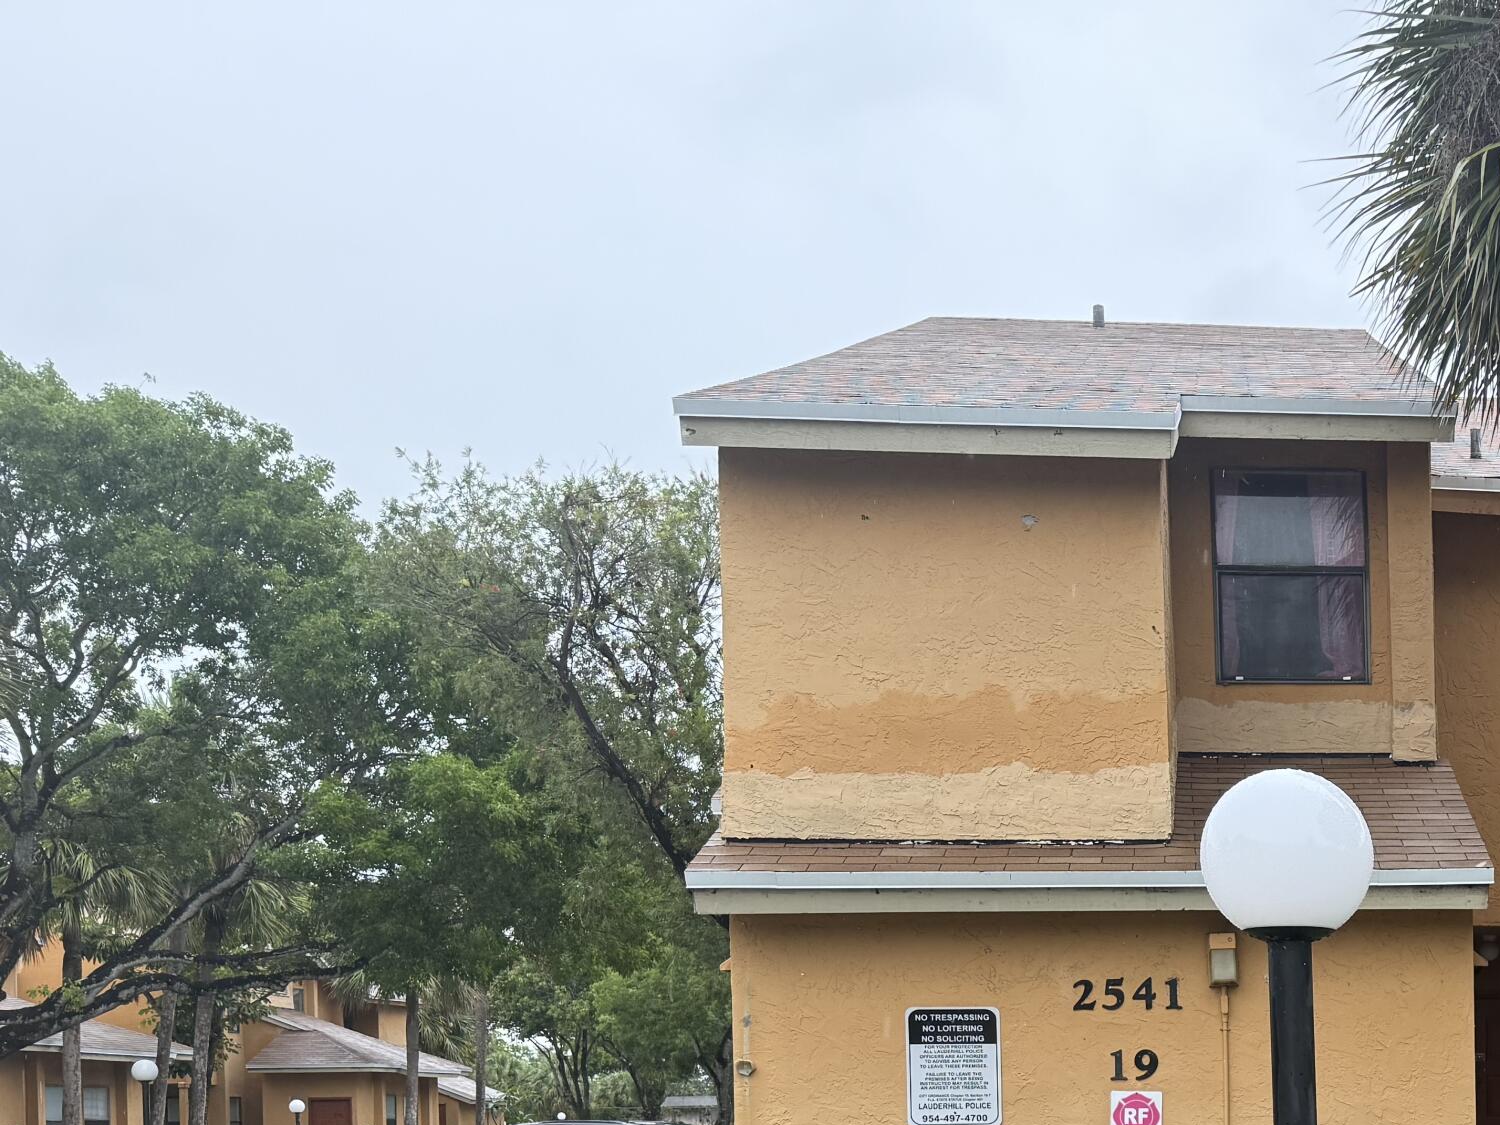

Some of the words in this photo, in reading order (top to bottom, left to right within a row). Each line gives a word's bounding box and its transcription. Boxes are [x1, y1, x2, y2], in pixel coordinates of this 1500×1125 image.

[1073, 977, 1183, 1011] 2541
[1110, 1049, 1158, 1081] 19
[1124, 1108, 1149, 1125] RF
